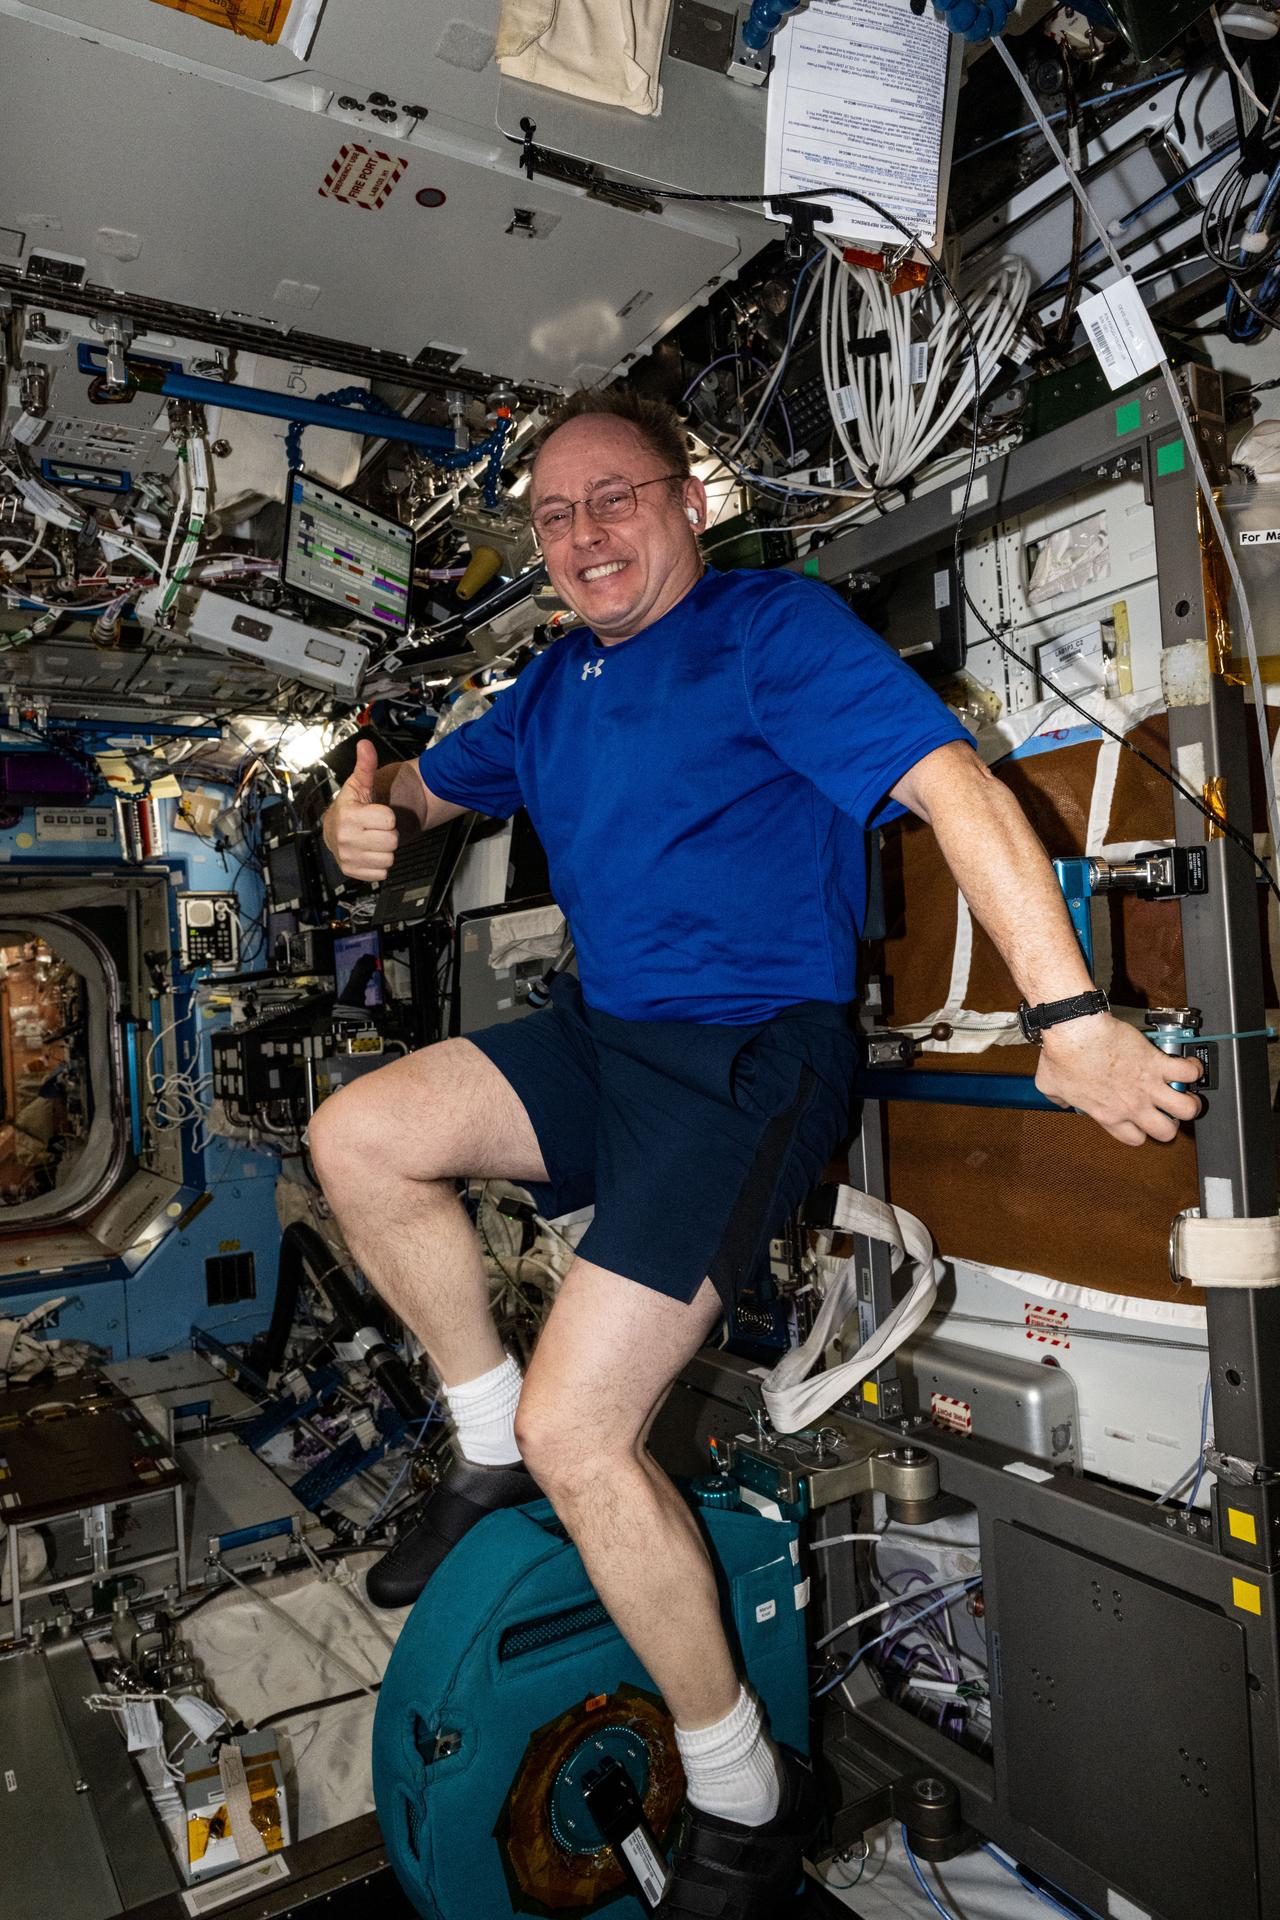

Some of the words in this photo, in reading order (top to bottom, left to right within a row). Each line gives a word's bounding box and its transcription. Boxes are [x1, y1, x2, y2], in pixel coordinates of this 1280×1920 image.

[332, 162, 353, 193] EMERGENCY
[350, 152, 360, 163] USE
[349, 181, 365, 198] FIRE
[359, 158, 378, 180] PORT
[850, 218, 879, 227] REFERENCE
[1242, 534, 1260, 542] For
[938, 1408, 952, 1417] PORT
[953, 1412, 966, 1422] FIRE
